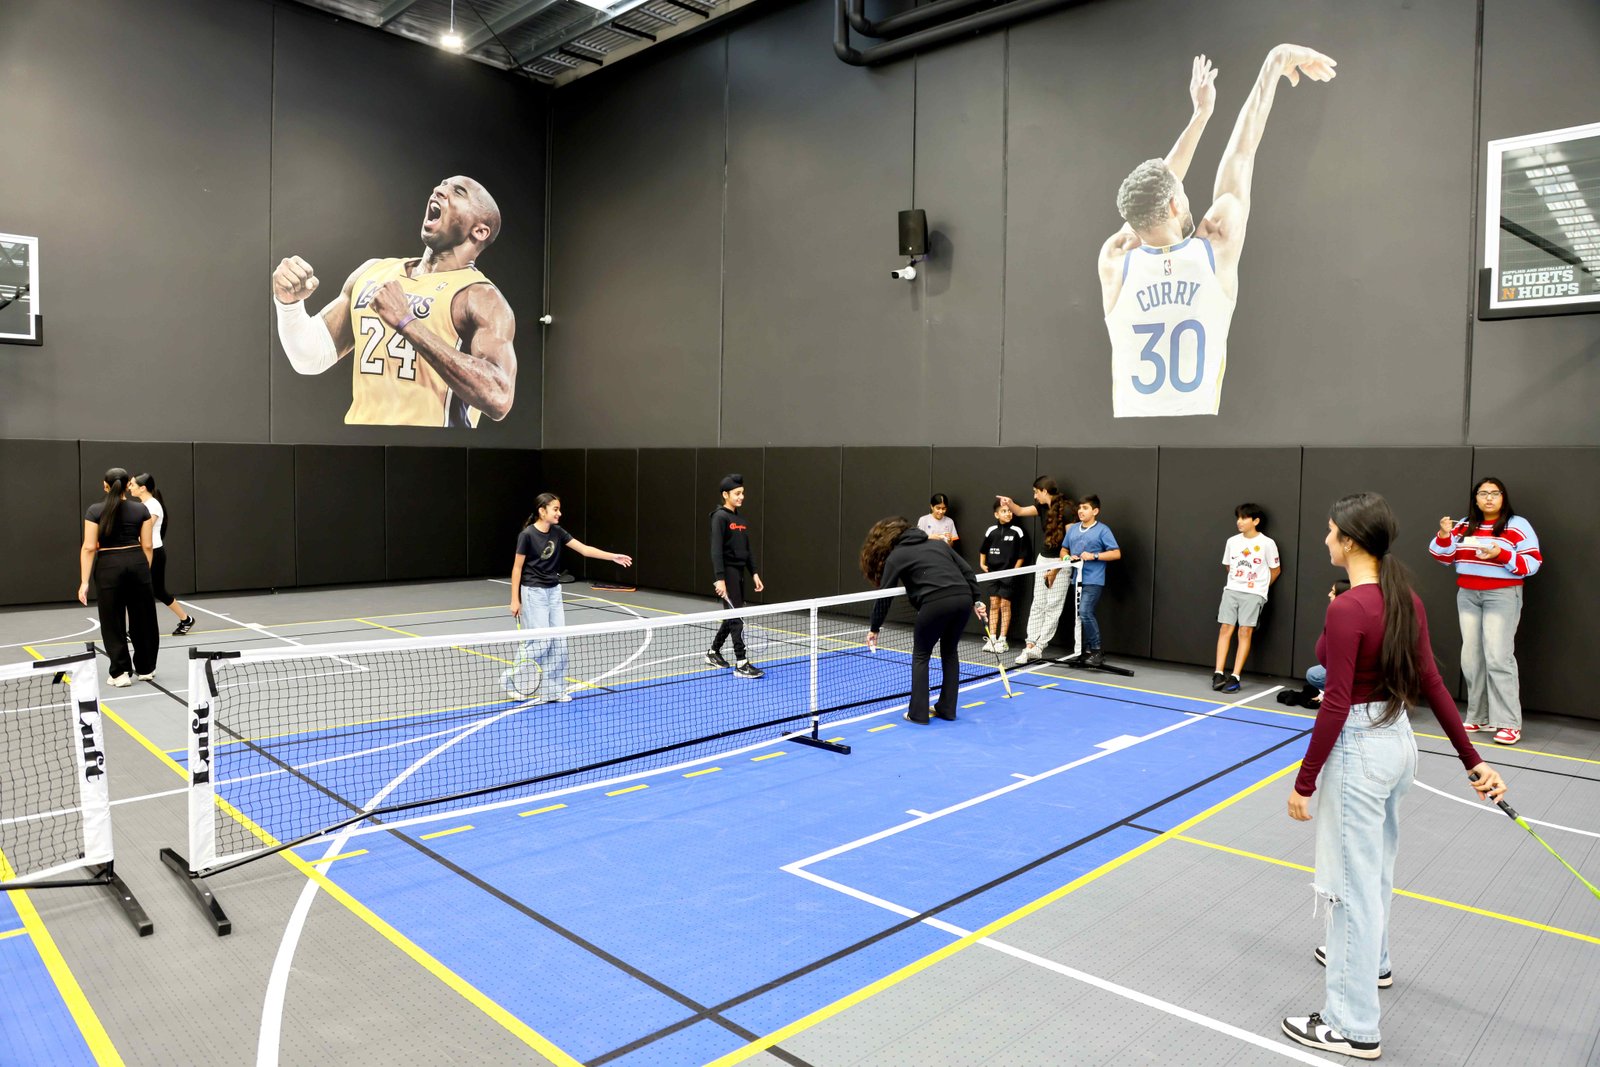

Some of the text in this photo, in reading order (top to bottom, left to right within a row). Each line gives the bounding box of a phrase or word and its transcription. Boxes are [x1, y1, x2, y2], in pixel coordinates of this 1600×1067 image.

[1136, 280, 1201, 312] CURRY
[1501, 269, 1574, 287] COURTS
[1502, 282, 1580, 300] N HOOPS
[360, 315, 417, 381] 24
[1131, 319, 1206, 394] 30
[78, 697, 104, 783] Luft
[192, 701, 210, 787] Luft
